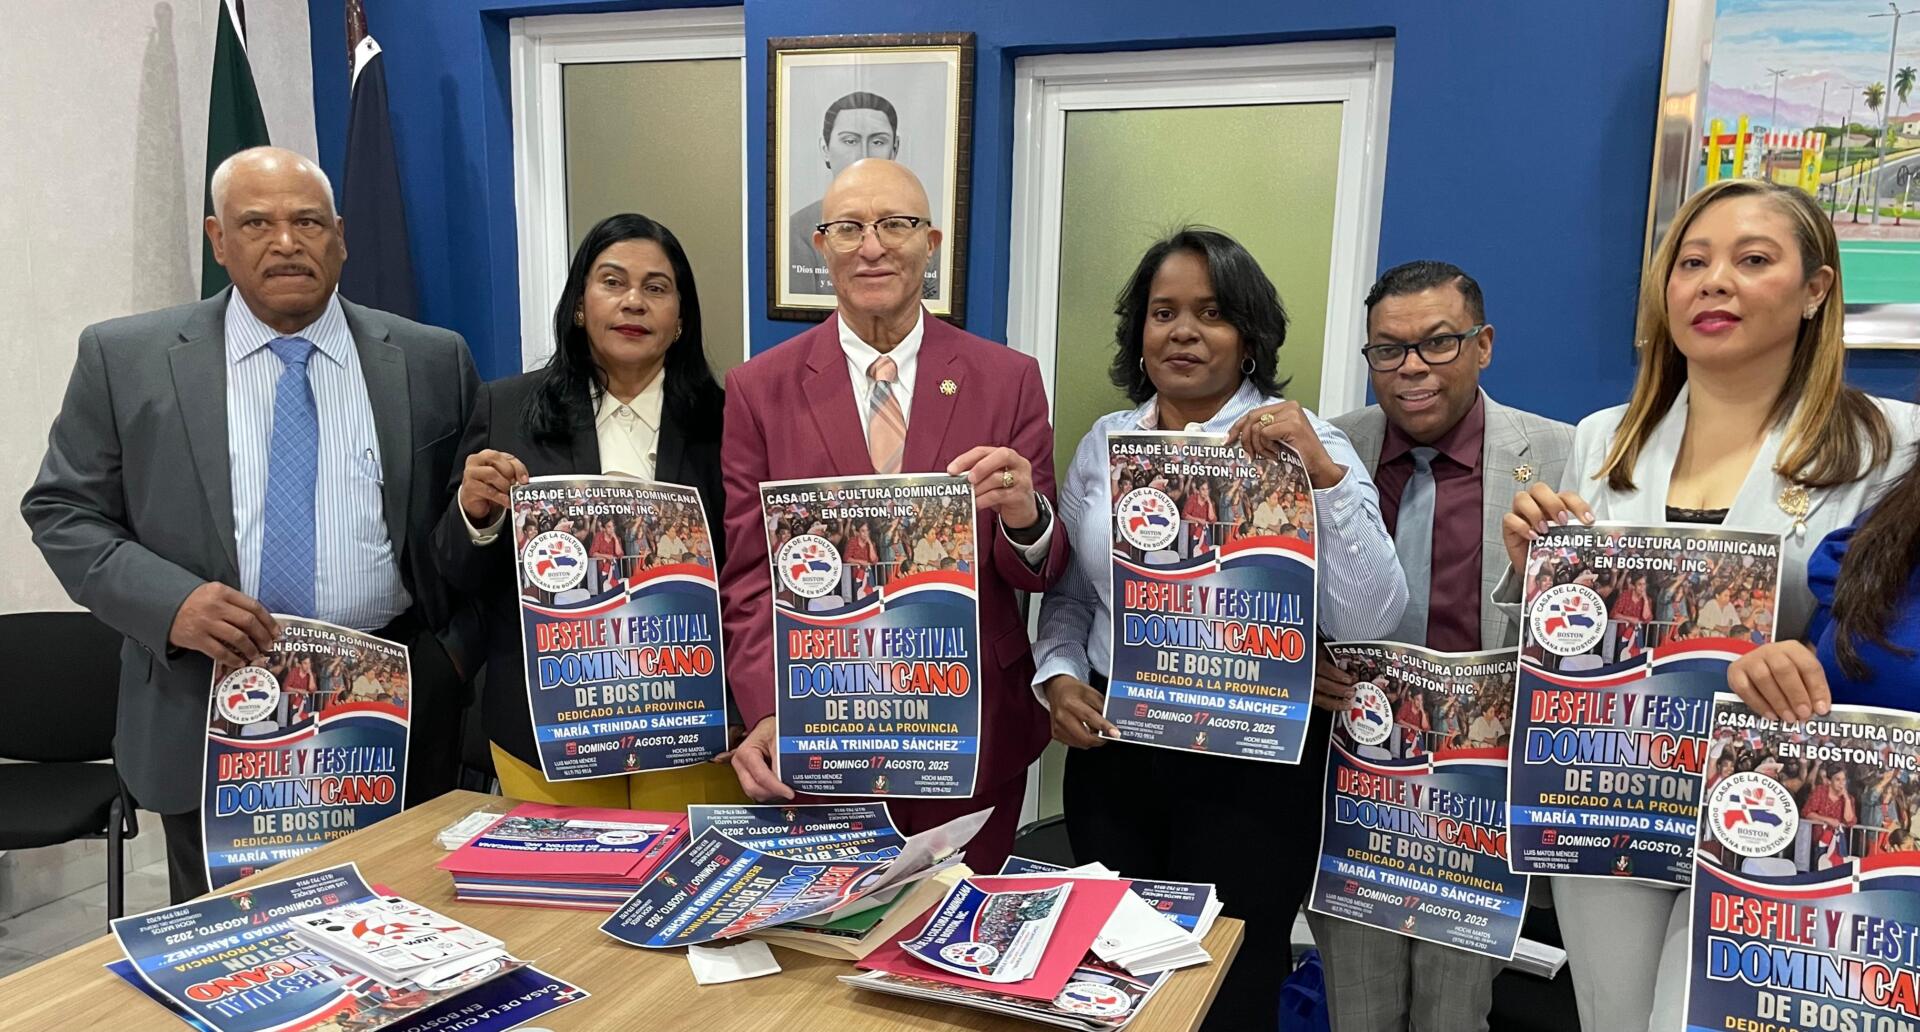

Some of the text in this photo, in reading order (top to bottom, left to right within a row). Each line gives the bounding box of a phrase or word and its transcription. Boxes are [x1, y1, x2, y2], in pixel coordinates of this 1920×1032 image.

[1112, 444, 1234, 459] CASA DE LA CULTURA
[1165, 464, 1179, 475] EN
[516, 488, 697, 504] CASA DE LA CULTURA DOMINICANA
[767, 484, 969, 505] CASA DE LA CULTURA DOMINICANA
[569, 506, 586, 516] EN
[822, 509, 838, 520] EN
[1536, 535, 1776, 557] CASA DE LA CULTURA DOMINICANA
[1595, 557, 1612, 568] EN
[1125, 580, 1303, 625] DESFILE Y FESTIVAL
[285, 627, 405, 658] CULTURA DOMINICANA
[536, 614, 711, 652] DESFILE Y FESTIVAL
[789, 628, 967, 659] DESFILE Y FESTIVAL
[1124, 613, 1305, 663] DOMINICANO
[538, 645, 714, 690] DOMINICANO
[1157, 651, 1260, 681] DE BOSTON
[1334, 647, 1519, 677] CASA DE LA CULTURA DOMINICAN
[1386, 667, 1399, 678] EN
[789, 661, 970, 698] DOMINICANO
[575, 681, 675, 707] DE BOSTON
[1169, 692, 1225, 708] TRINIDAD
[826, 700, 928, 720] DE BOSTON
[1531, 690, 1709, 734] DESFILE Y FESTI
[593, 719, 648, 733] TRINIDAD
[805, 724, 958, 733] DEDICADO A LA PROVINCIA
[1718, 712, 1887, 740] CASA DE LA CULTURA
[578, 741, 619, 754] DOMINGO
[620, 736, 635, 749] 17
[678, 735, 698, 744] 2025
[841, 740, 899, 750] TRINIDAD
[1525, 727, 1708, 776] DOMINICA
[1779, 743, 1799, 758] EN
[219, 747, 395, 781] DESFILE Y FESTIVAL
[823, 759, 869, 770] DOMINGO
[870, 756, 885, 769] 17
[928, 761, 949, 771] 2025
[216, 775, 395, 817] DOMINICANO
[1337, 766, 1508, 828] DESFILE Y FESTIVA
[1565, 769, 1693, 802] DE BOSTON
[1716, 782, 1733, 802] CASA
[1733, 776, 1745, 784] DE
[1761, 778, 1792, 813] CULTURA
[254, 809, 354, 834] DE BOSTON
[1580, 814, 1650, 829] TRINIDAD
[1738, 828, 1769, 837] BOSTON
[1369, 832, 1474, 873] DE BOSTON
[1380, 872, 1437, 894] TRINIDAD
[252, 913, 269, 925] 17
[268, 897, 322, 916] DOMINGO
[1711, 892, 1817, 947] DESFILE
[1825, 910, 1843, 949] Y
[166, 930, 194, 945] 2025
[1707, 936, 1920, 1019] DOMINICA
[478, 984, 559, 1019] CASA DE LA
[1757, 991, 1914, 1032] DE BOSTON
